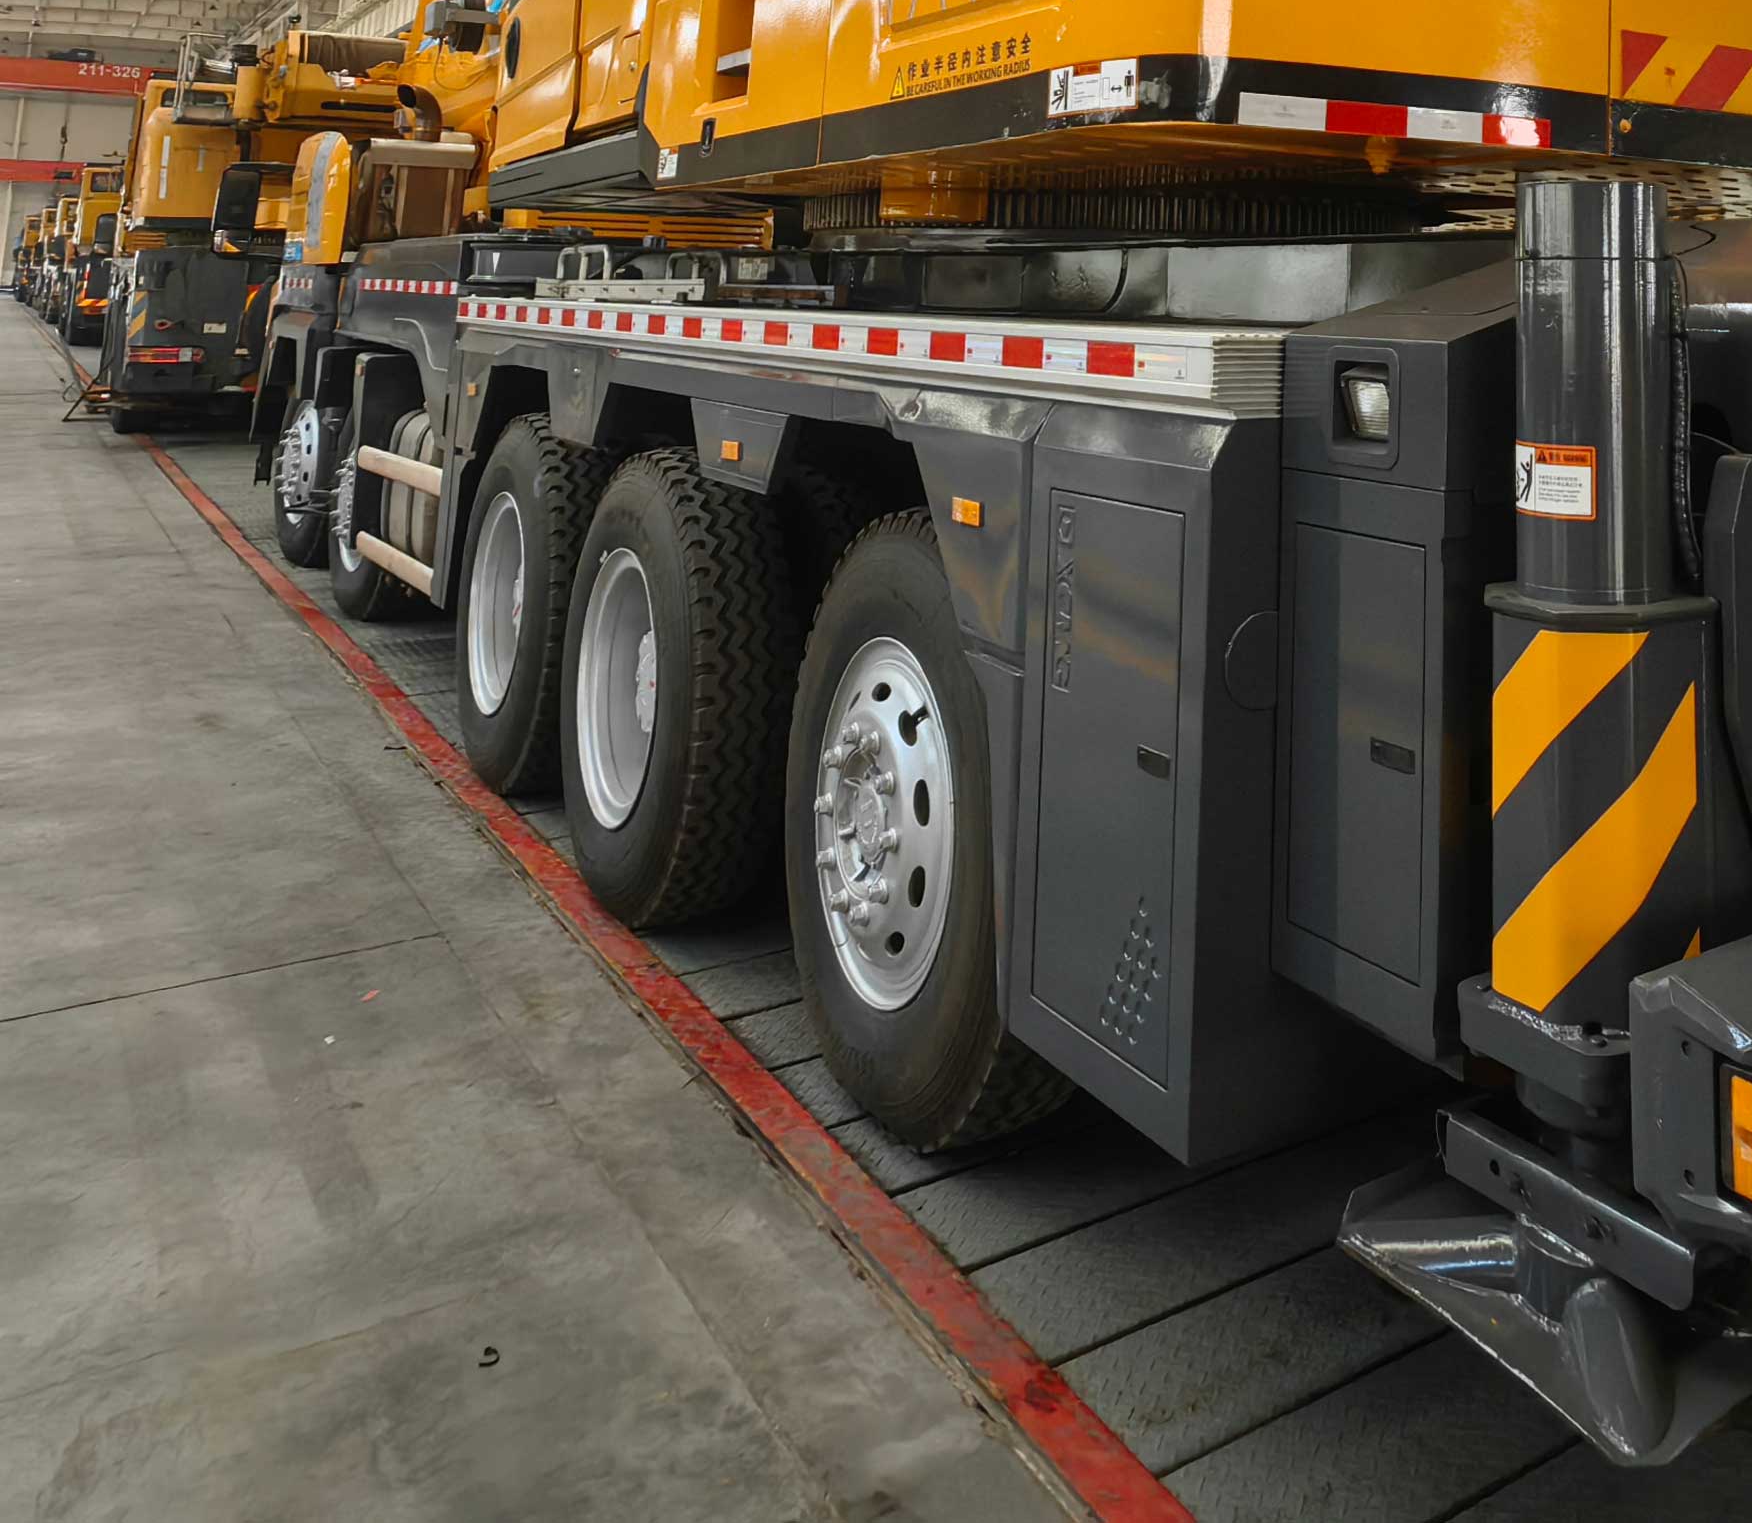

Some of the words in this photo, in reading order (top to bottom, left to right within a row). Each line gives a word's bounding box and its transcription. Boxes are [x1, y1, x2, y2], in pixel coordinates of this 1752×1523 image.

[78, 63, 141, 78] 211-326
[908, 32, 1031, 81] 作业半径内注意安全
[914, 77, 943, 95] CAREFUL
[953, 73, 966, 87] THE
[967, 65, 1002, 83] WORKING
[1003, 58, 1031, 77] RADIUS
